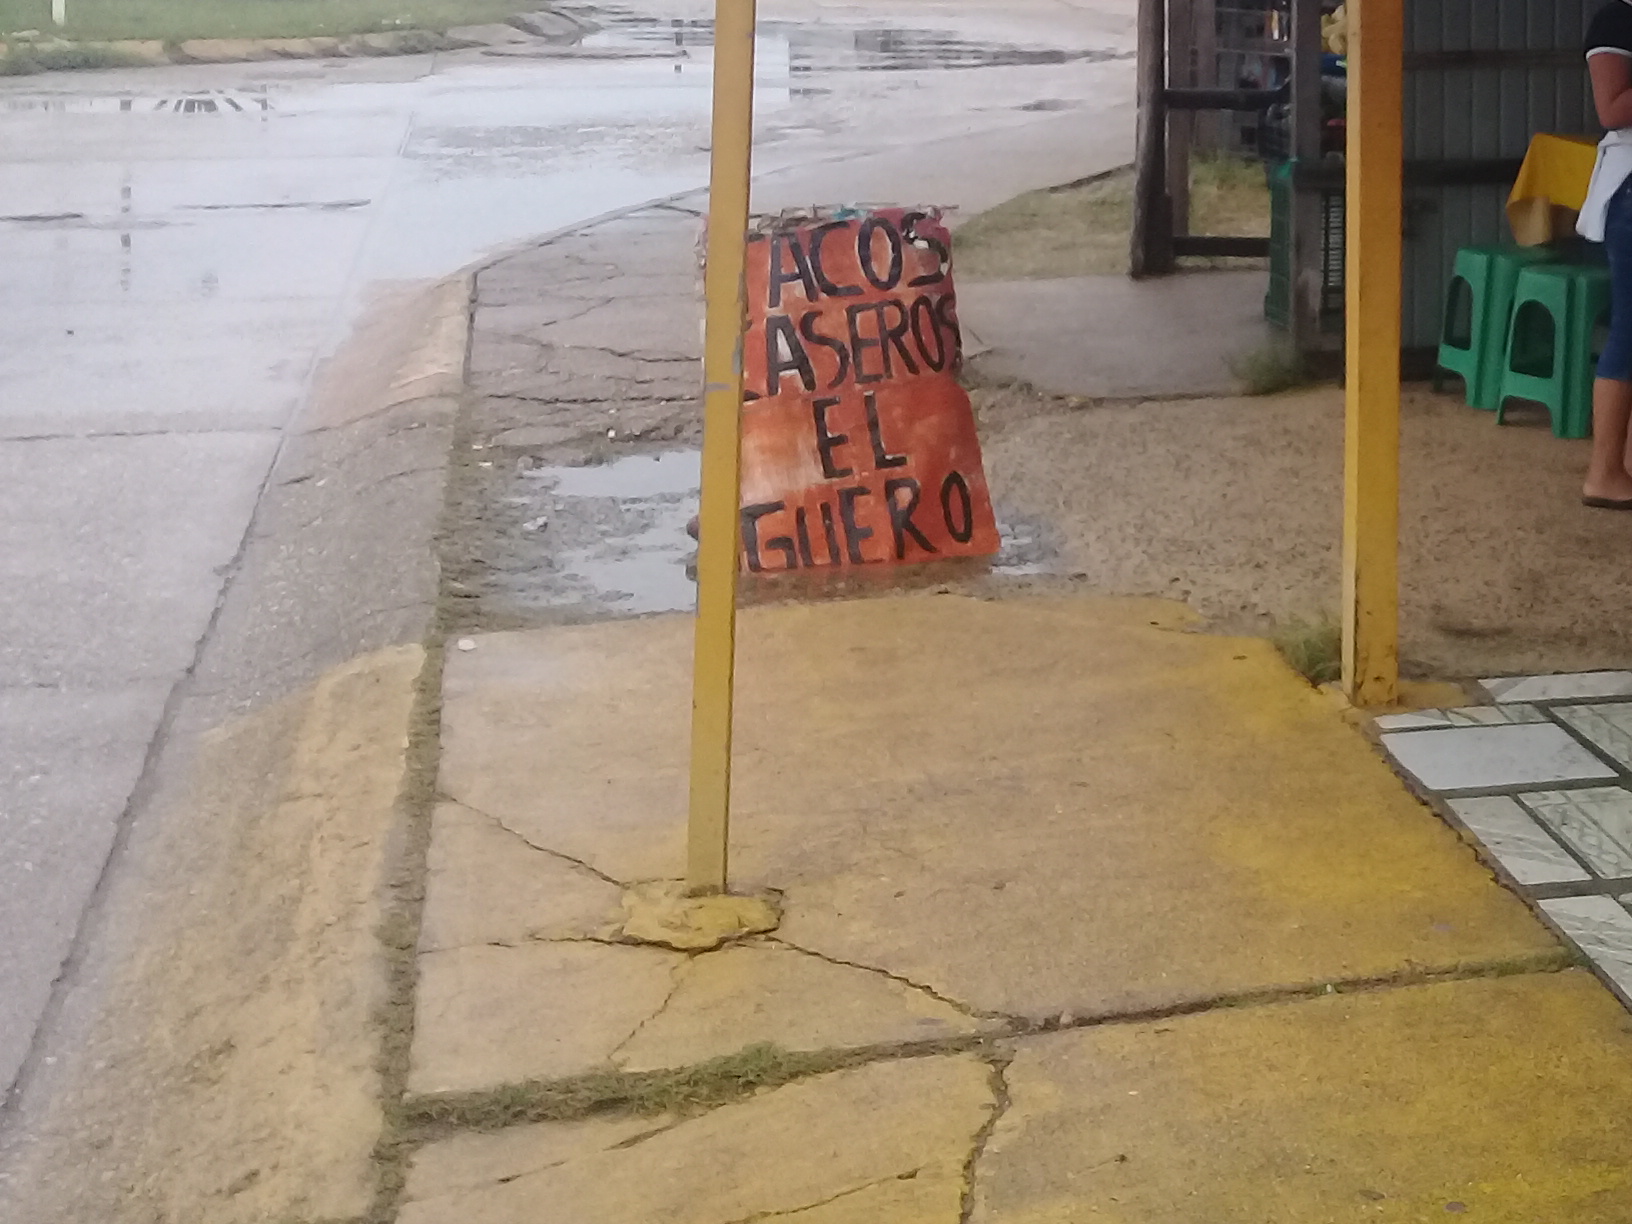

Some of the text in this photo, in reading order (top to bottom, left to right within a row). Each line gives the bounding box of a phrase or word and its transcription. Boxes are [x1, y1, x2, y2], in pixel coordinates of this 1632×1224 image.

[747, 211, 949, 309] ACOS
[745, 293, 963, 402] ASEROS
[812, 391, 908, 480] EL
[740, 470, 974, 573] GUERO
